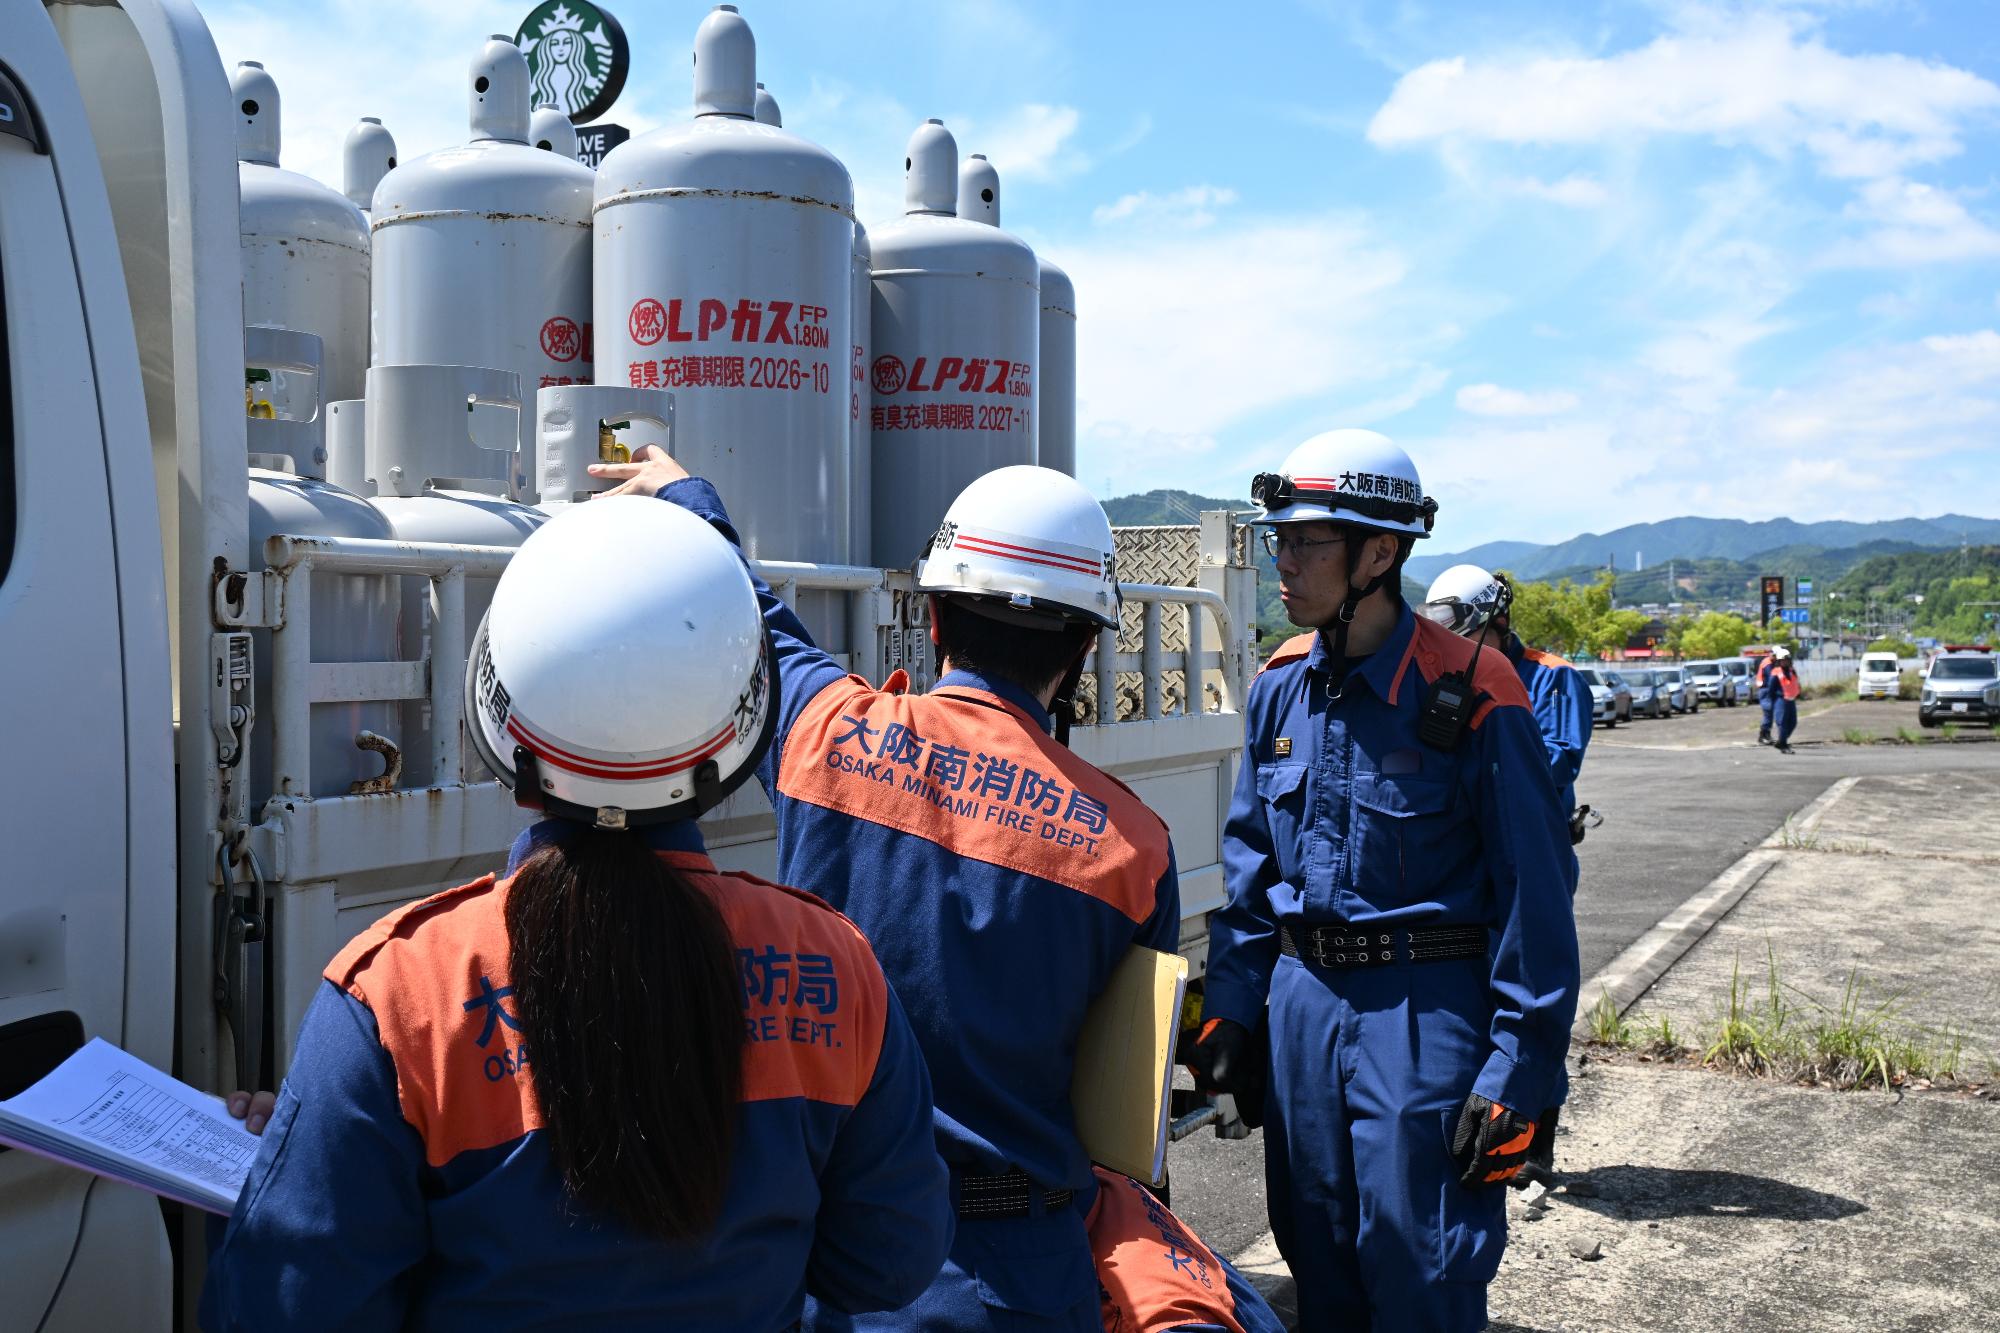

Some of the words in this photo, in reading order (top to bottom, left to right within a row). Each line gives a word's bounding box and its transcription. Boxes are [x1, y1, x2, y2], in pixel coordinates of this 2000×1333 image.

[799, 304, 828, 323] FP
[793, 326, 829, 350] 1.80M
[749, 356, 829, 394] 2026-10
[1010, 362, 1031, 379] FP
[1008, 380, 1032, 398] 1.80M
[978, 405, 1031, 433] 2027-11
[833, 714, 1109, 835] 大阪南消防局
[826, 751, 895, 787] OSAKA
[901, 773, 979, 820] MINAMI
[984, 803, 1036, 834] FIRE
[1039, 821, 1101, 858] DEPT.
